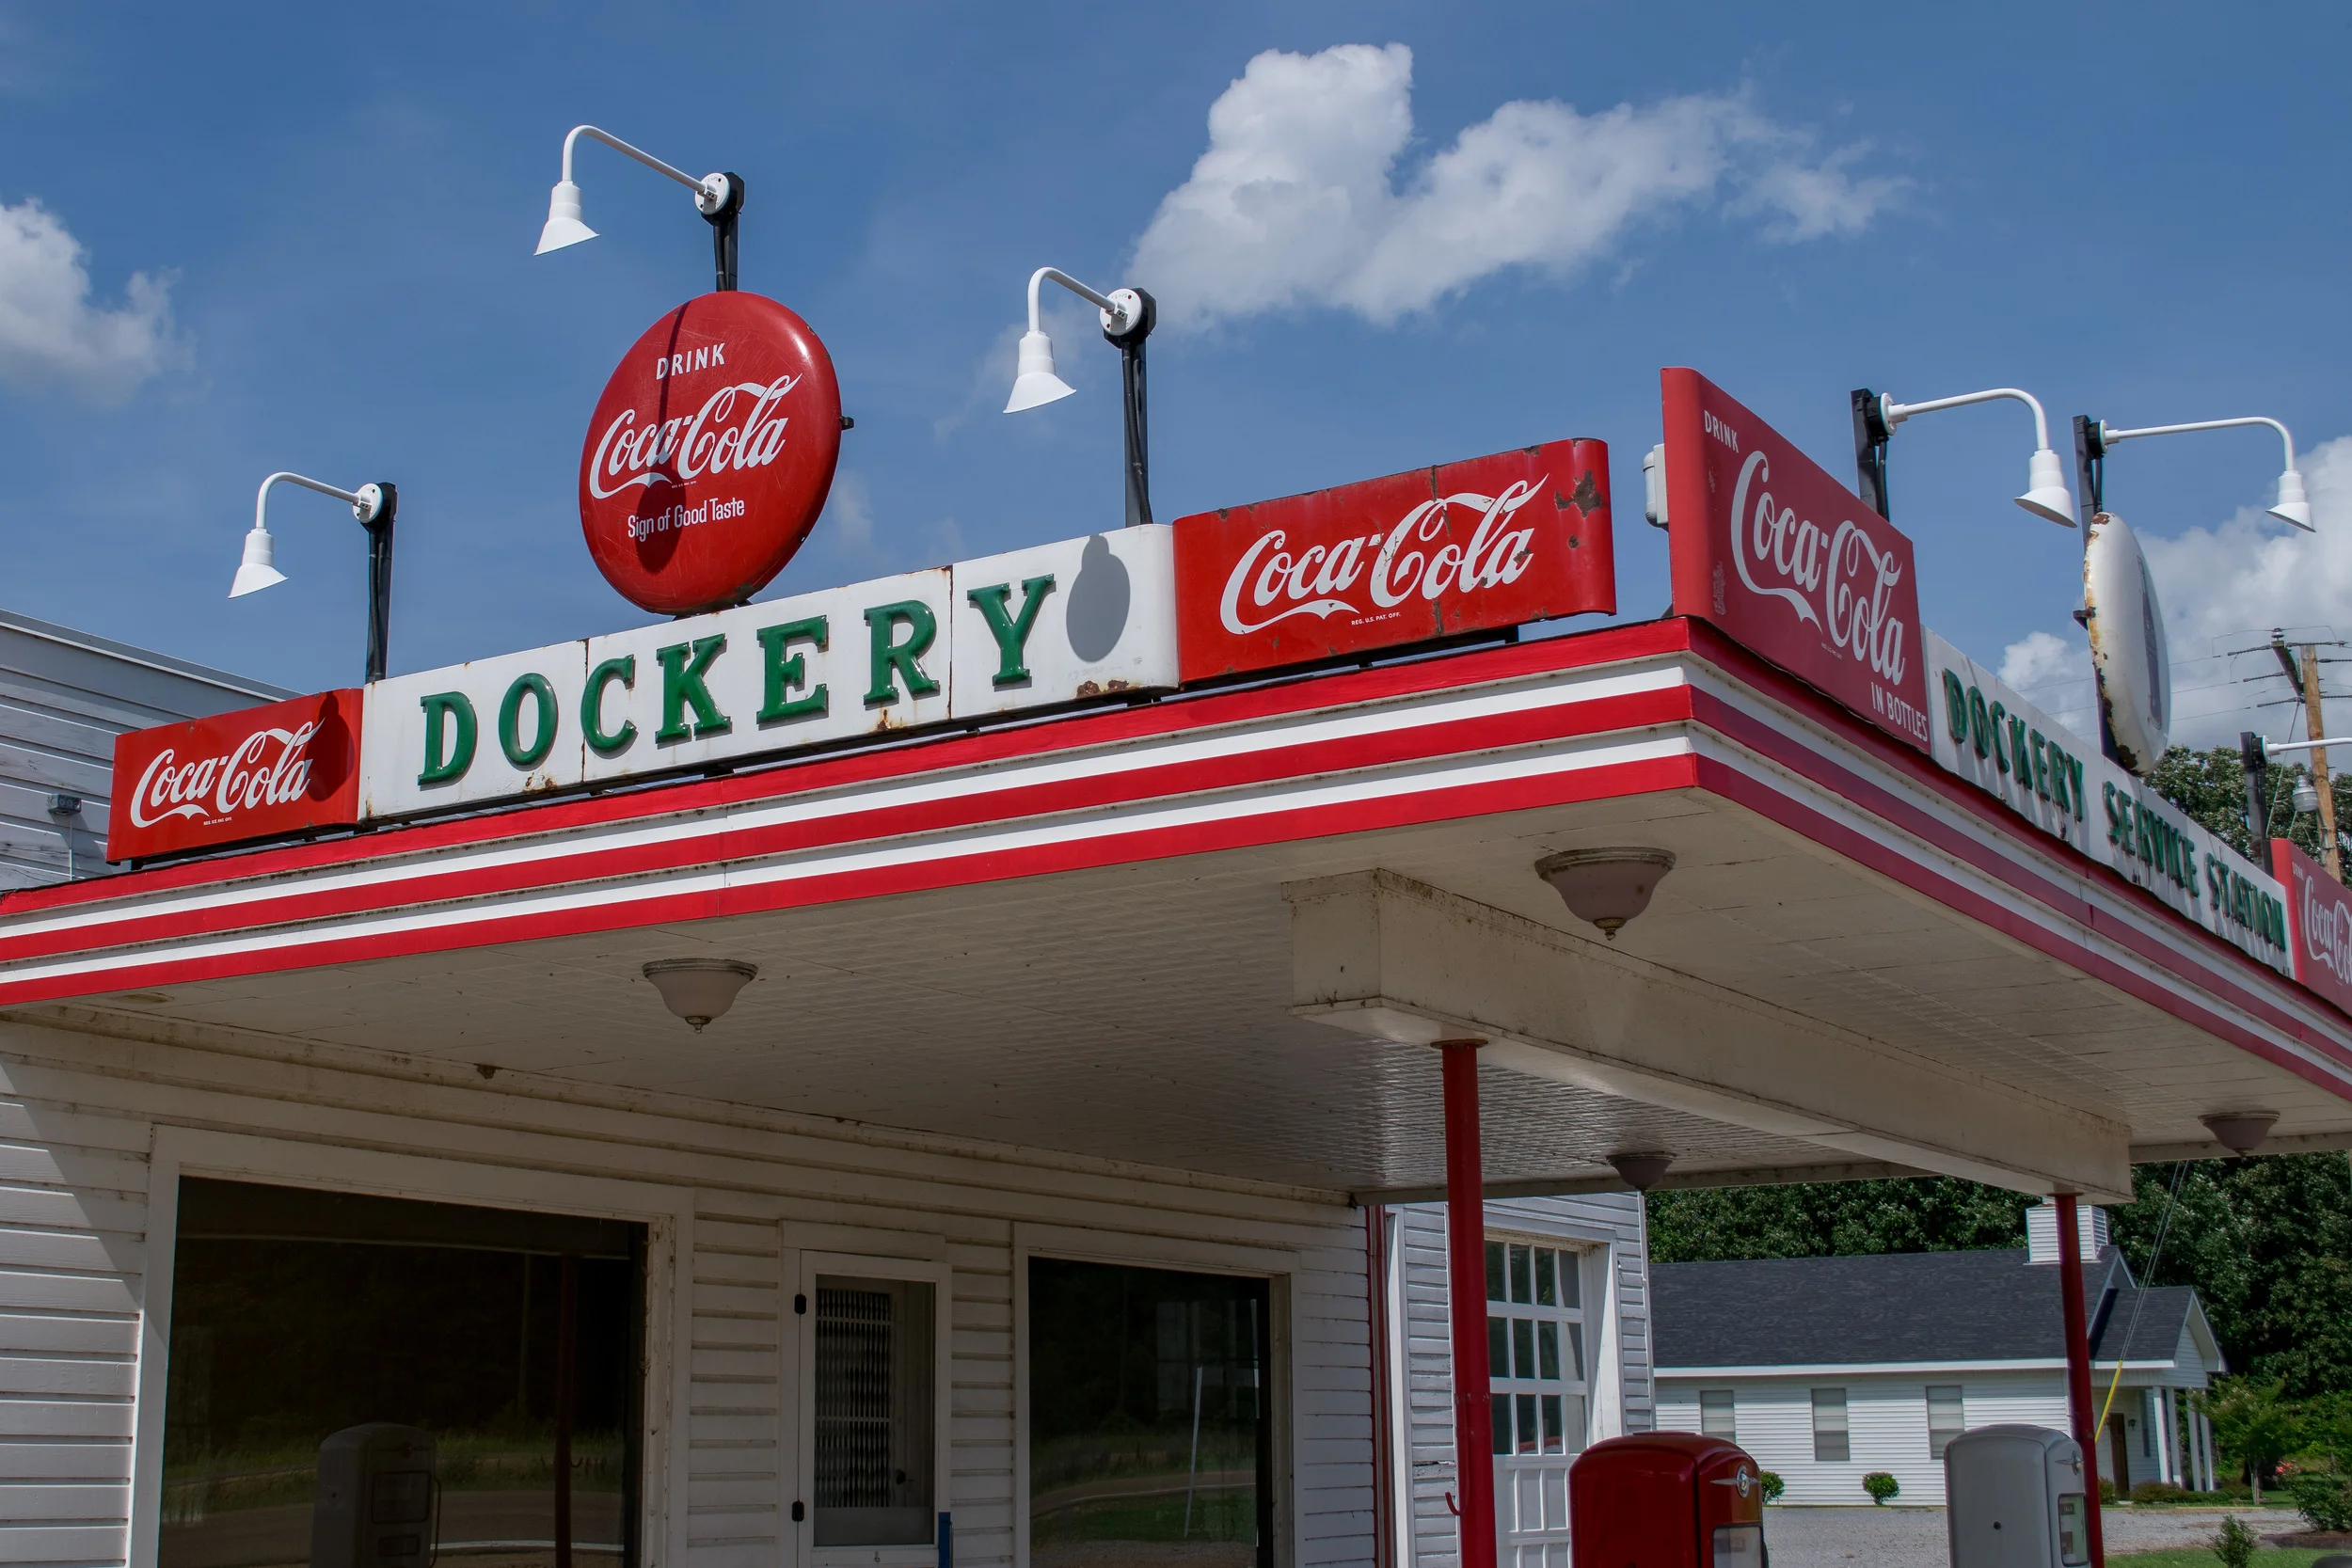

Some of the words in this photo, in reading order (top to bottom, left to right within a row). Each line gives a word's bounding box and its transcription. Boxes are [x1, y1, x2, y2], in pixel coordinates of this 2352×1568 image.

[657, 343, 725, 380] DRINK
[589, 372, 803, 499] Coca-Cola
[1704, 409, 1739, 453] DRINK
[628, 515, 655, 542] Sign
[657, 507, 672, 531] of
[674, 499, 707, 528] Good
[709, 497, 745, 520] Taste
[1220, 473, 1549, 635] Coca-Cola
[1731, 451, 1905, 686] Coca-Cola
[417, 572, 1056, 788] DOCKERY
[1871, 681, 1884, 715] IN
[1886, 691, 1928, 742] BOTTLES
[130, 717, 325, 828] Coca-Cola
[1944, 667, 2084, 823] DOCKERY
[2101, 779, 2201, 899] SERVICE
[2205, 851, 2287, 954] STATION
